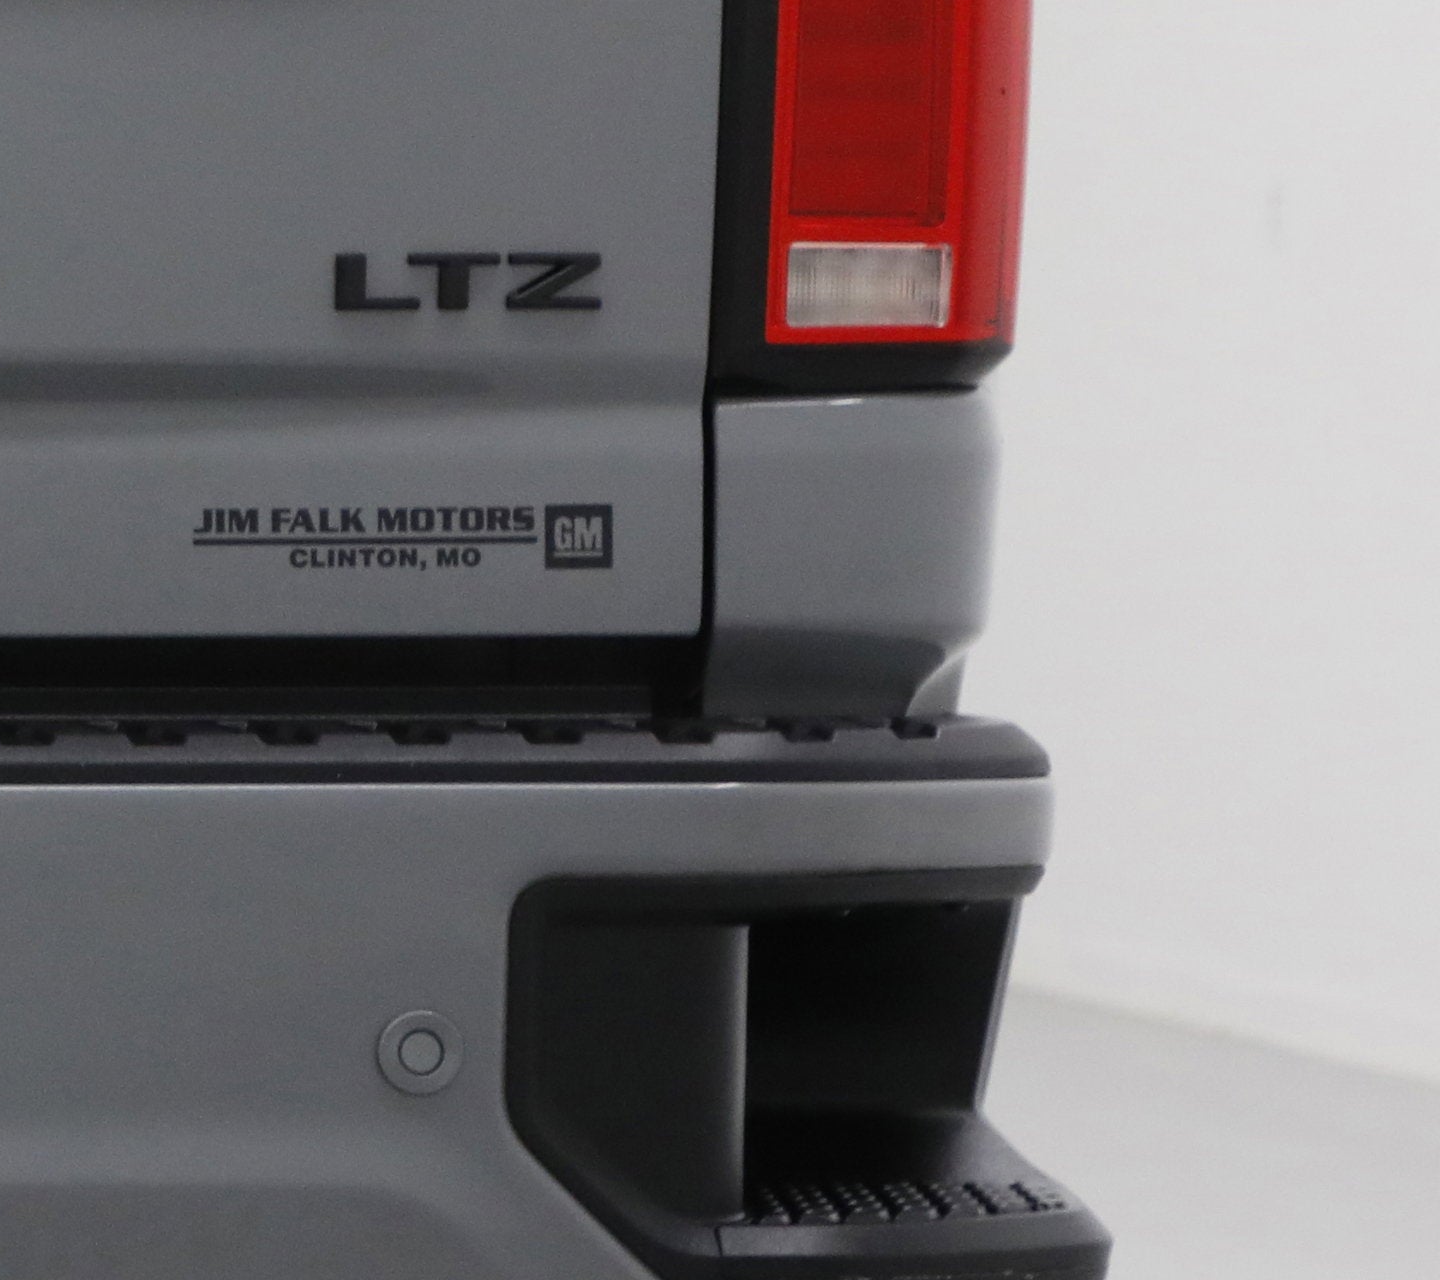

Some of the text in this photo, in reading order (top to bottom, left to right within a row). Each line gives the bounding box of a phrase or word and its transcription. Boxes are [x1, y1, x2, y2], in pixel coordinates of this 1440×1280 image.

[334, 252, 602, 311] LTZ
[193, 505, 536, 535] JIM FALK MOTORS
[553, 515, 603, 551] GM
[288, 547, 483, 573] CLINTON, MO
